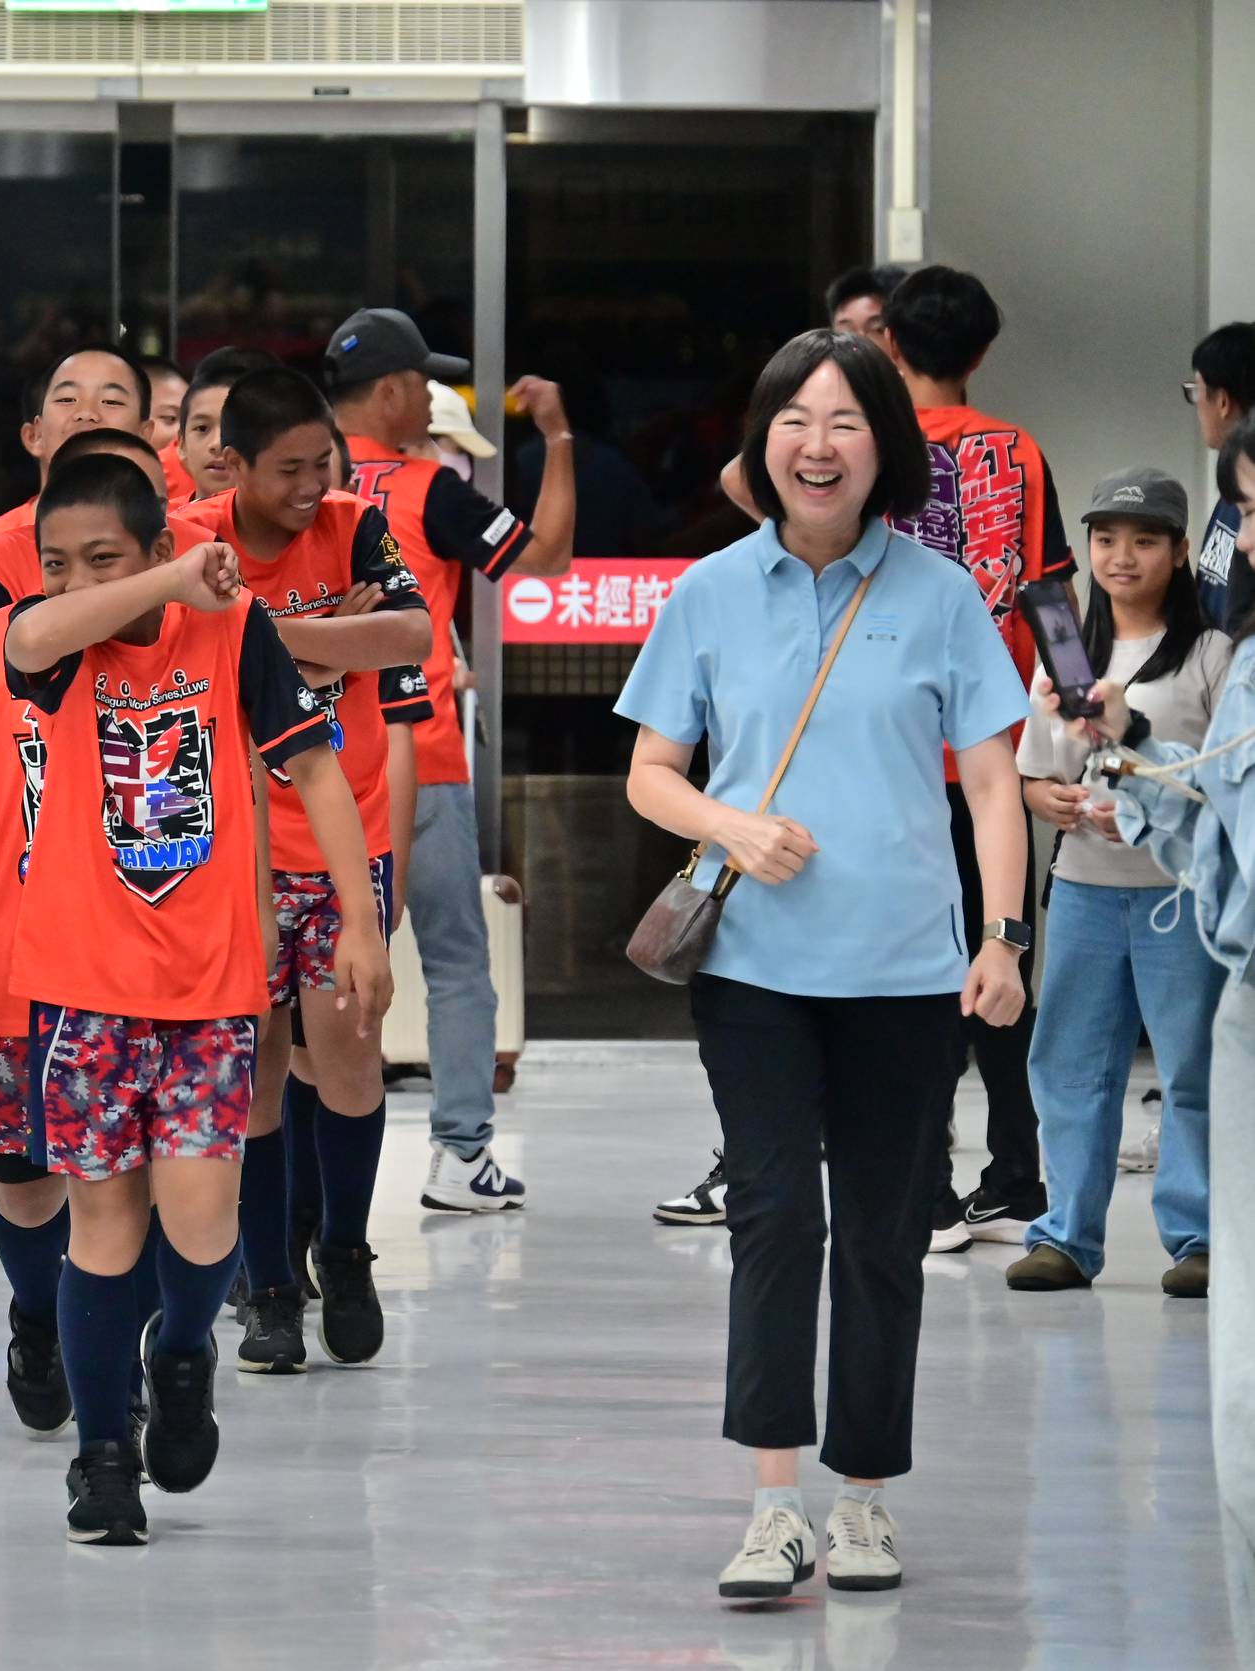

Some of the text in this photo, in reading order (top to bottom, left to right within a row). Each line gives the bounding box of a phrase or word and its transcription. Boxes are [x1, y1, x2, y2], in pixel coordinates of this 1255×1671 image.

[957, 432, 1023, 570] 紅葉
[267, 607, 295, 618] World
[557, 573, 677, 628] 未經許
[96, 690, 127, 708] League
